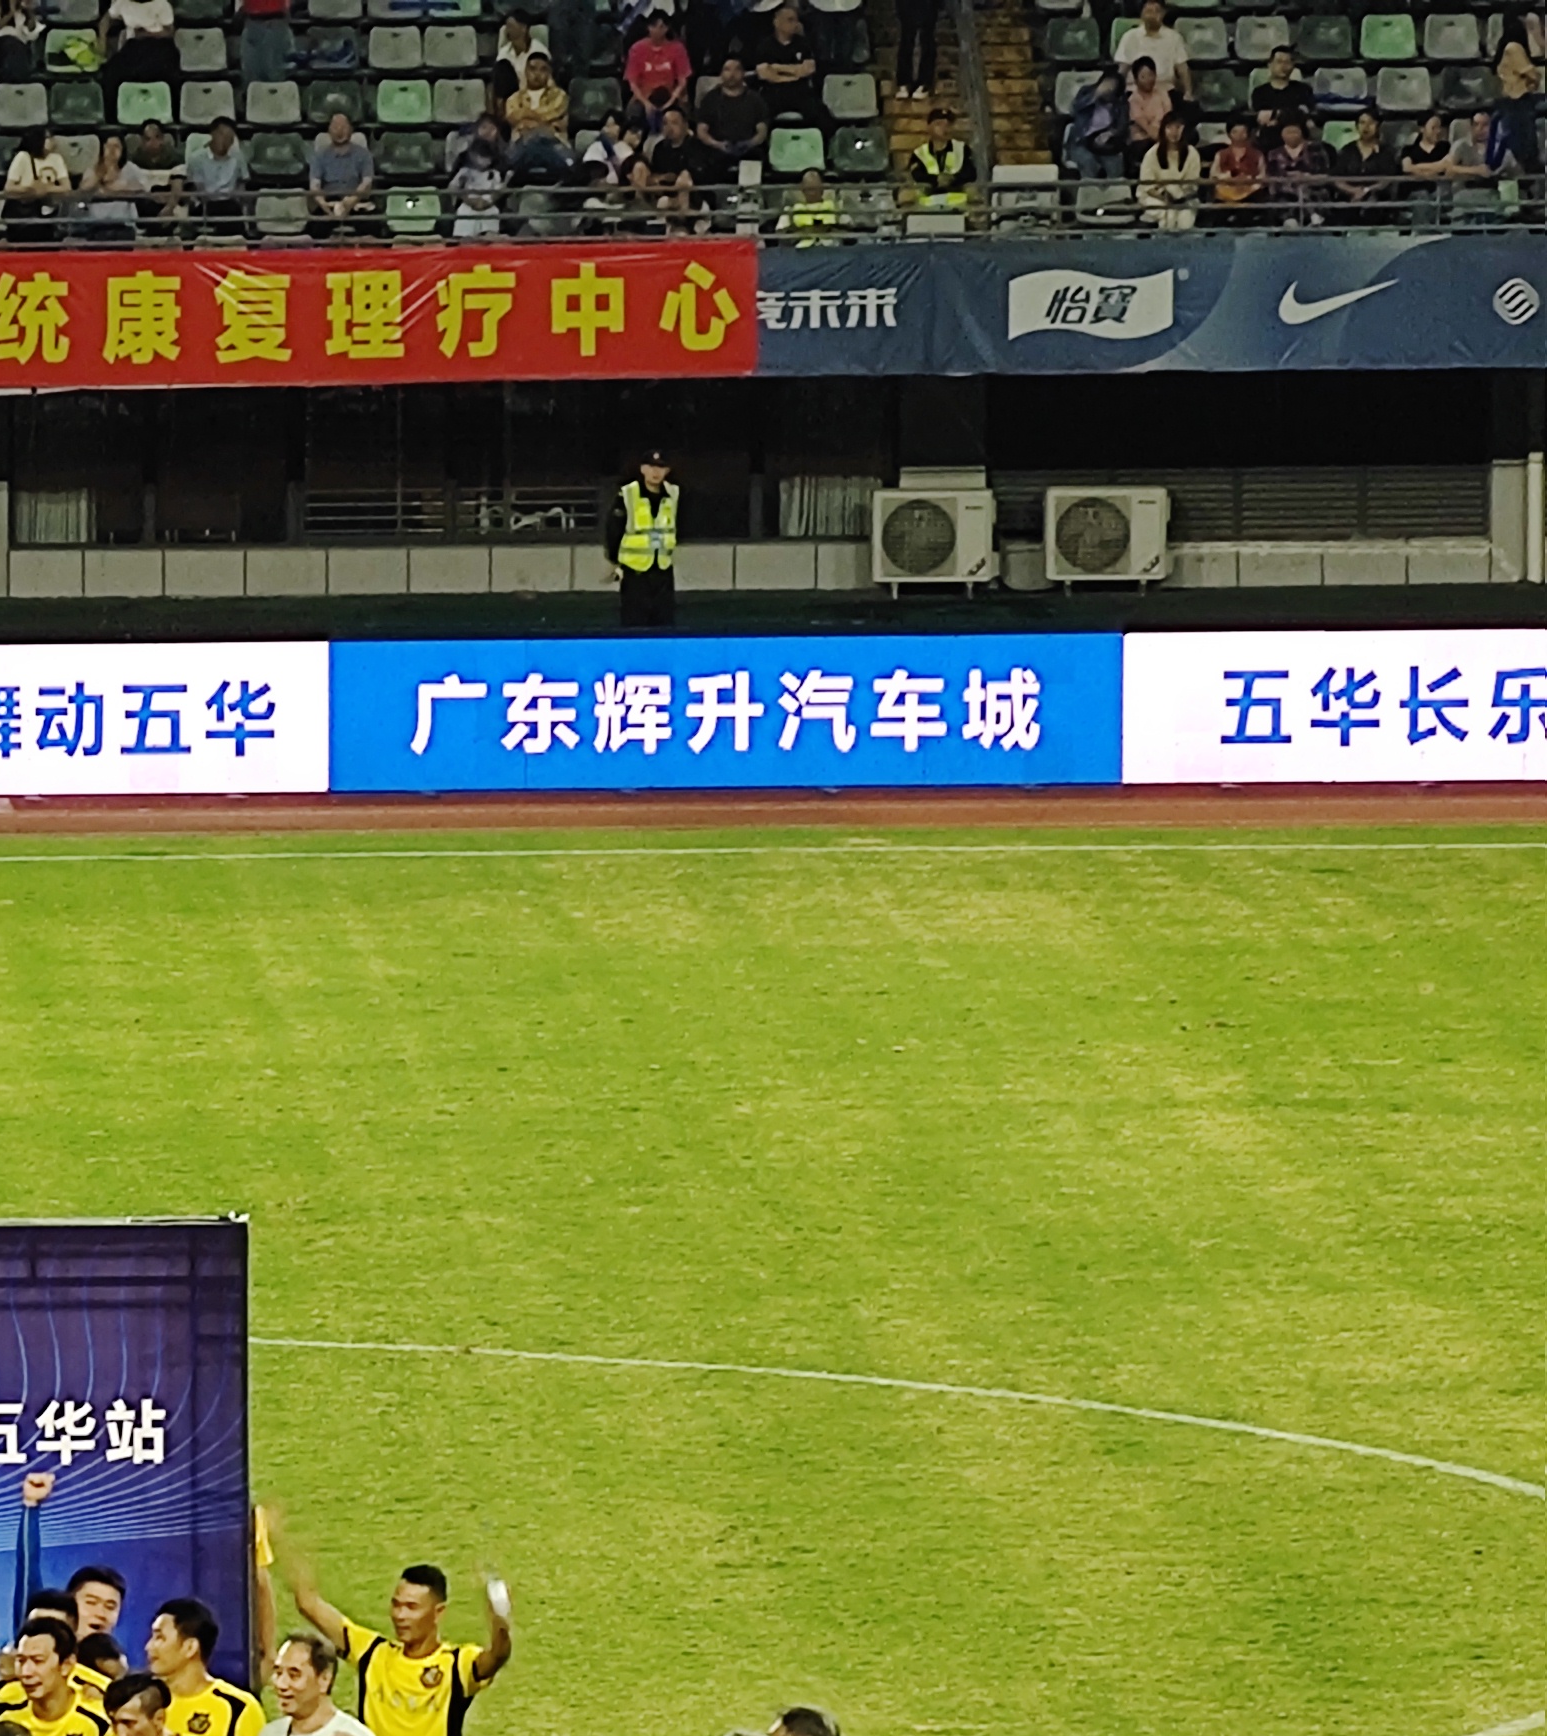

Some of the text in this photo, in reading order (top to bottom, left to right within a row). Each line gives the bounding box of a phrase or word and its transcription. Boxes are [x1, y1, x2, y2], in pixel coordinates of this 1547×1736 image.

[409, 668, 1042, 756] 广东辉升汽车城
